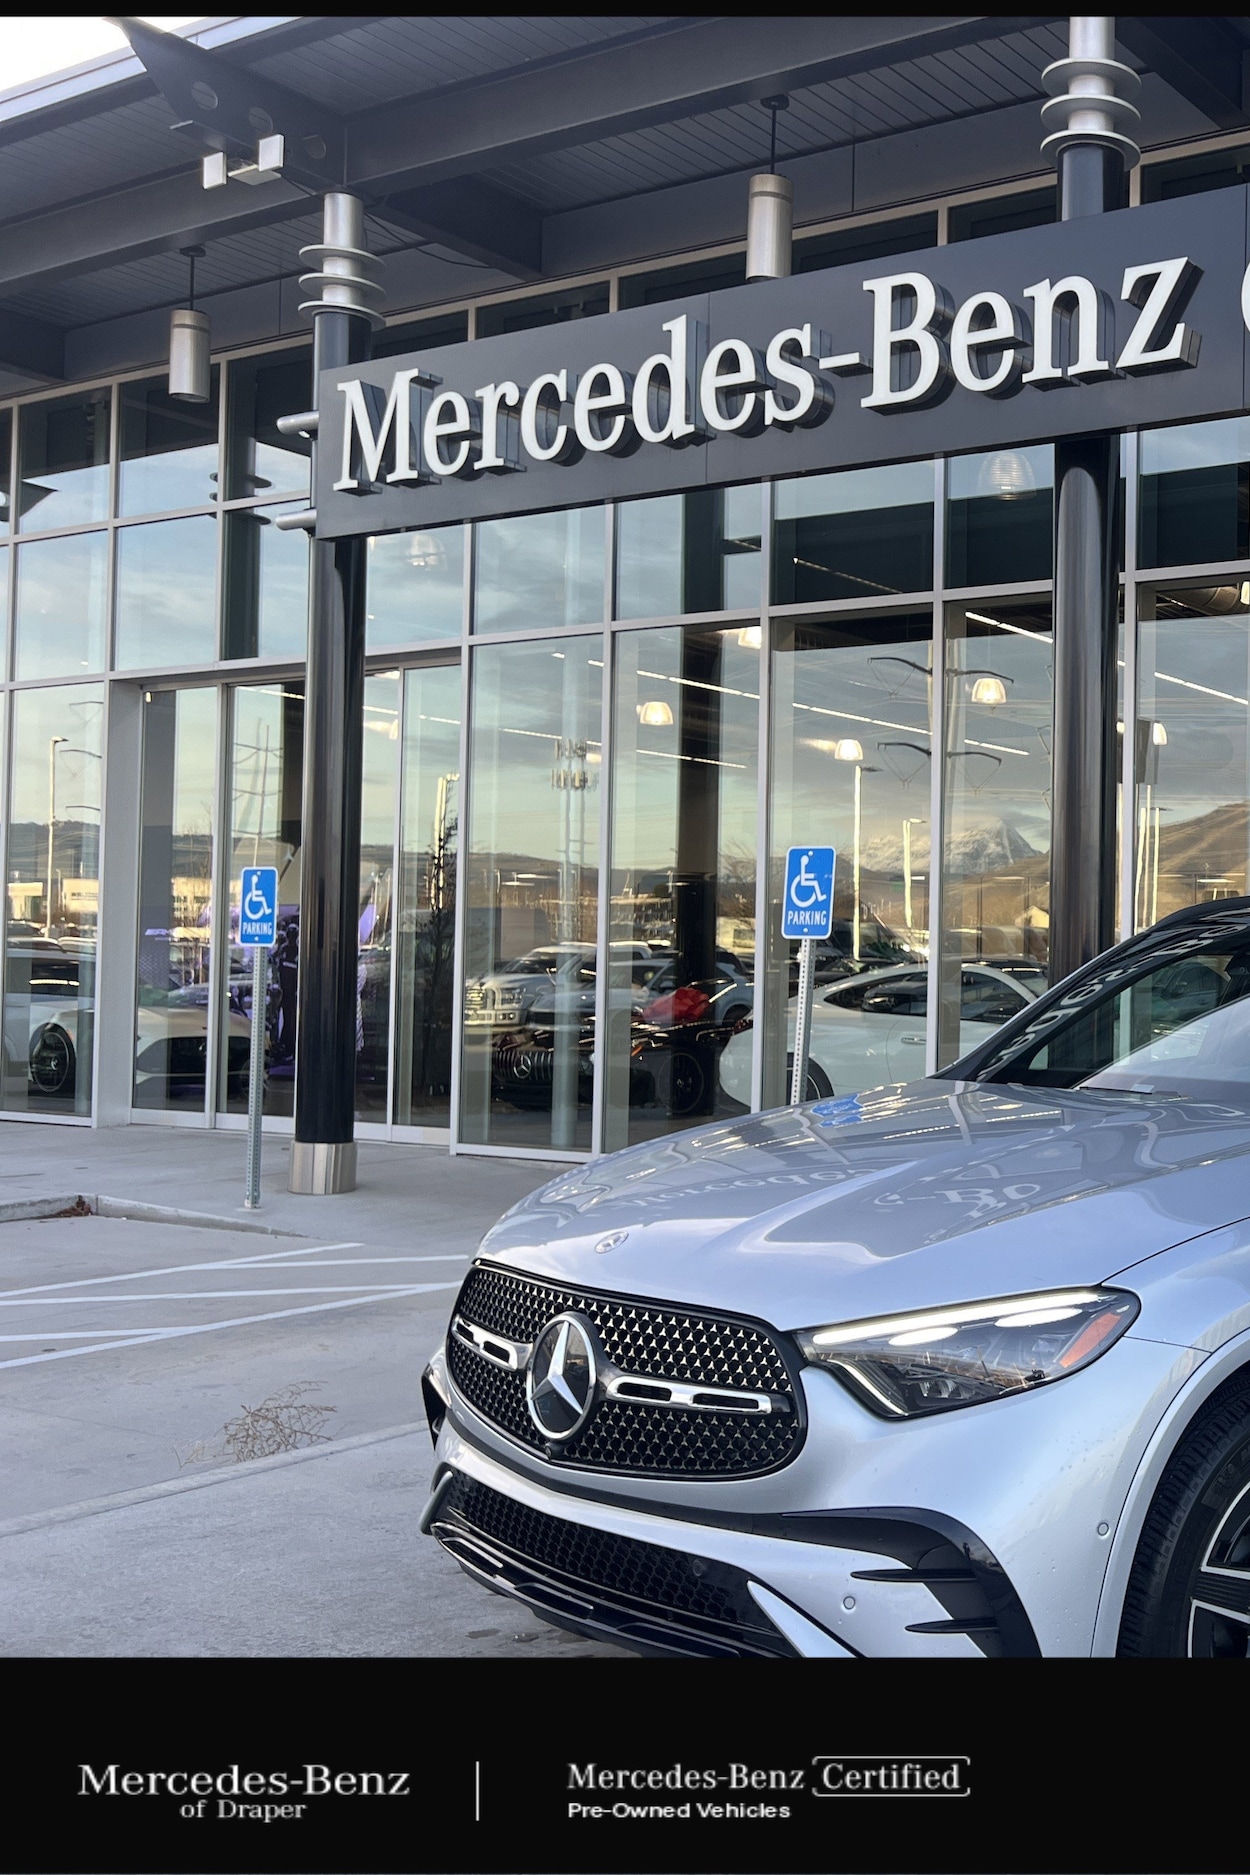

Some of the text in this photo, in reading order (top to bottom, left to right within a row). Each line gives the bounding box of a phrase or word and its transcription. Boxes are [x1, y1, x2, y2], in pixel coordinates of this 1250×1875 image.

[332, 256, 1194, 491] Mercedes-Benz
[786, 909, 828, 927] PARKING
[242, 921, 273, 936] PARKING
